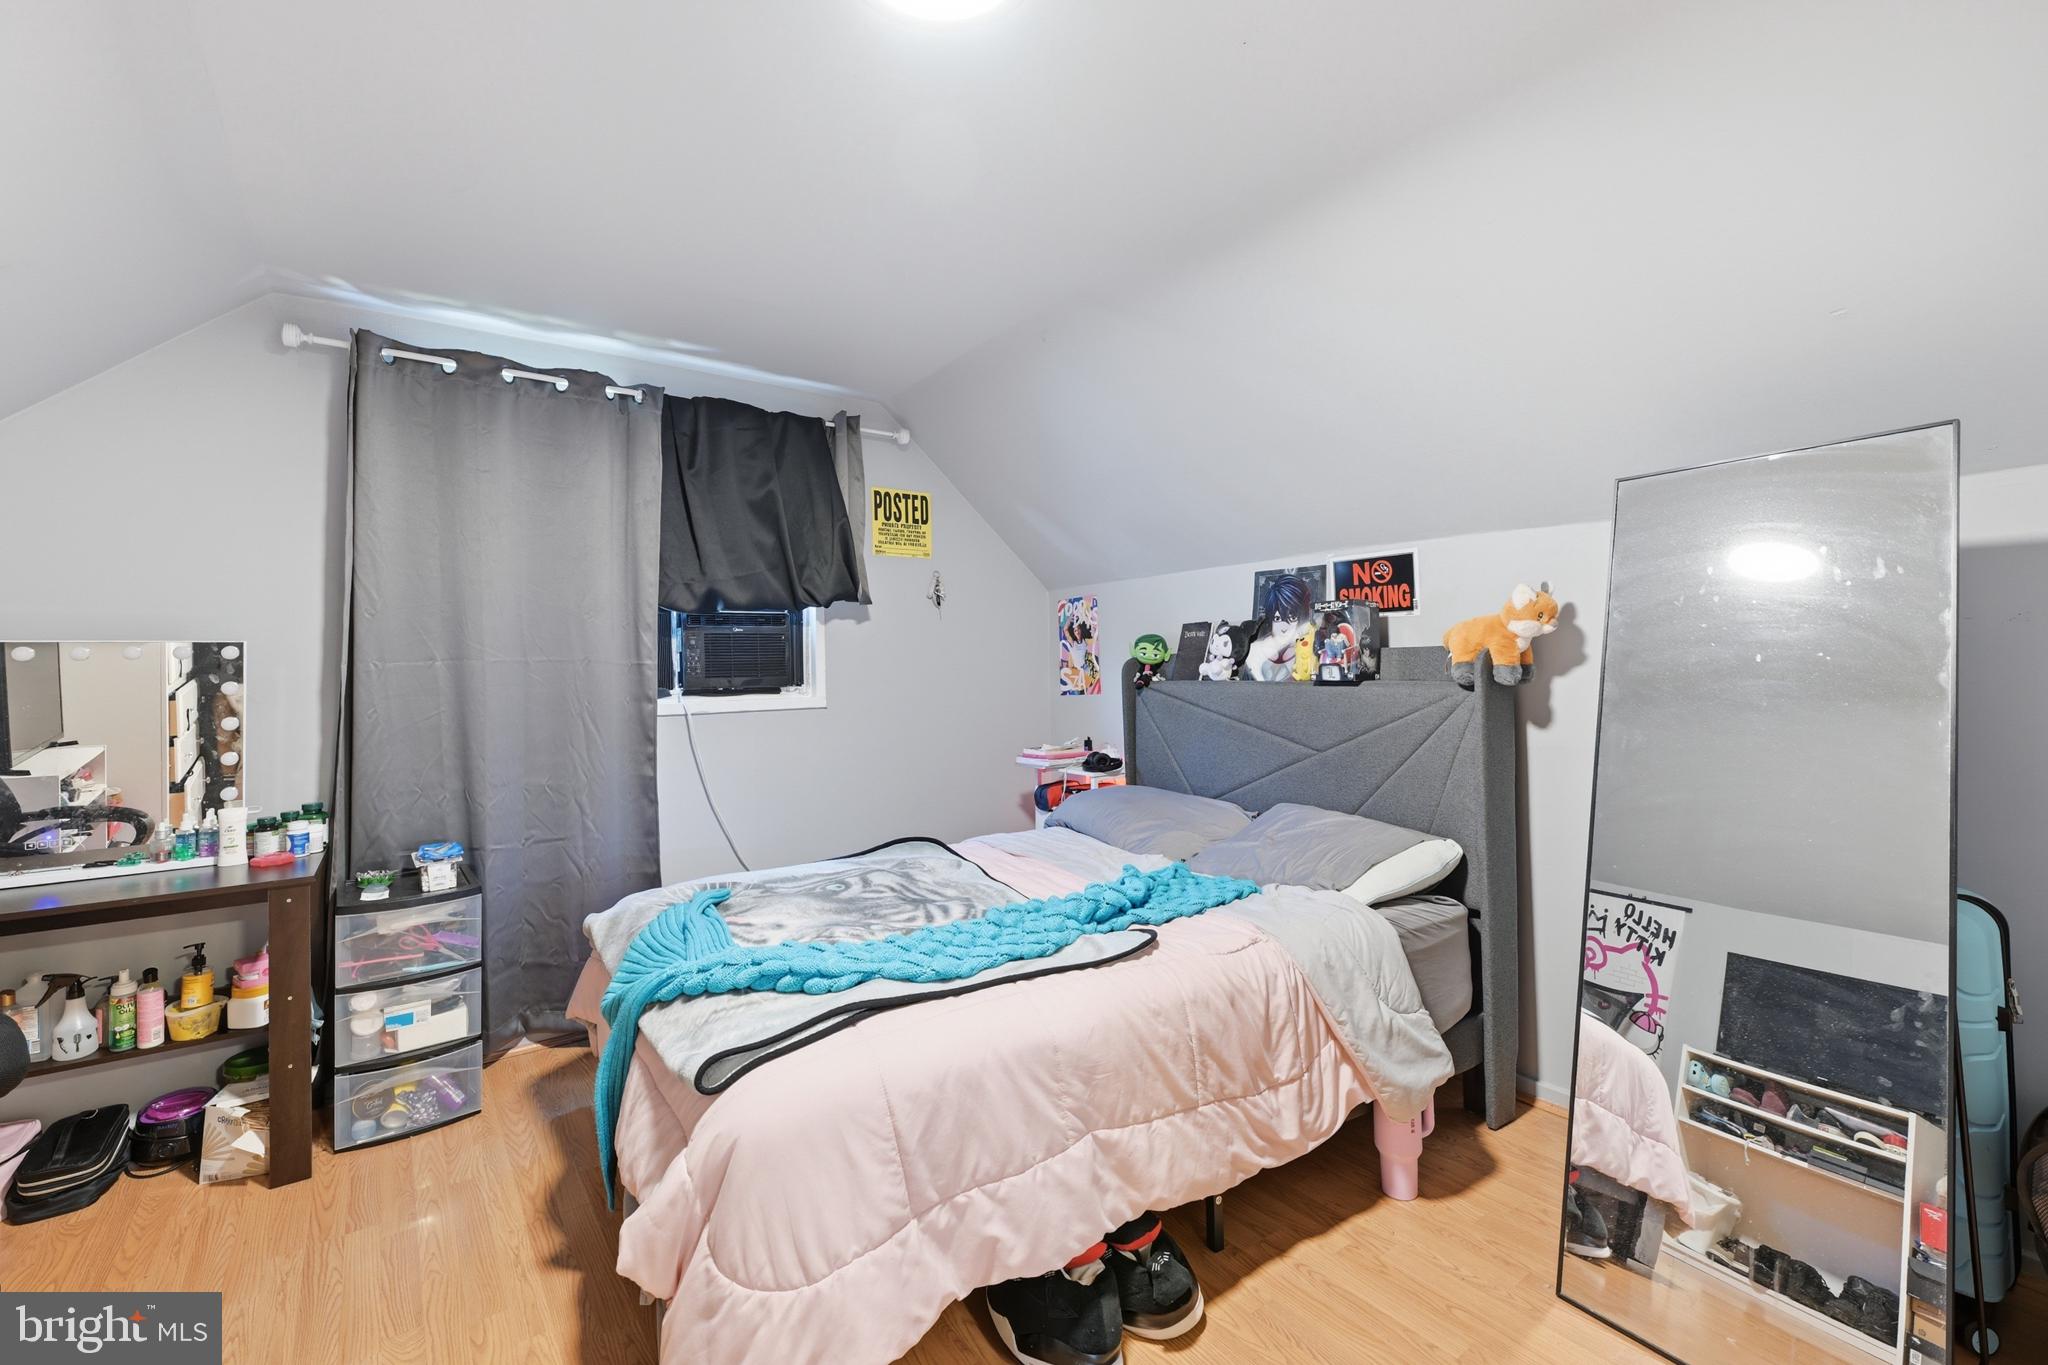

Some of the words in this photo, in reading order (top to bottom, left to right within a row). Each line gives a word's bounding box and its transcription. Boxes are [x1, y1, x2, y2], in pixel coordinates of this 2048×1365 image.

[874, 490, 929, 525] POSTED
[1352, 559, 1393, 586] NO
[115, 1000, 136, 1010] OLIV
